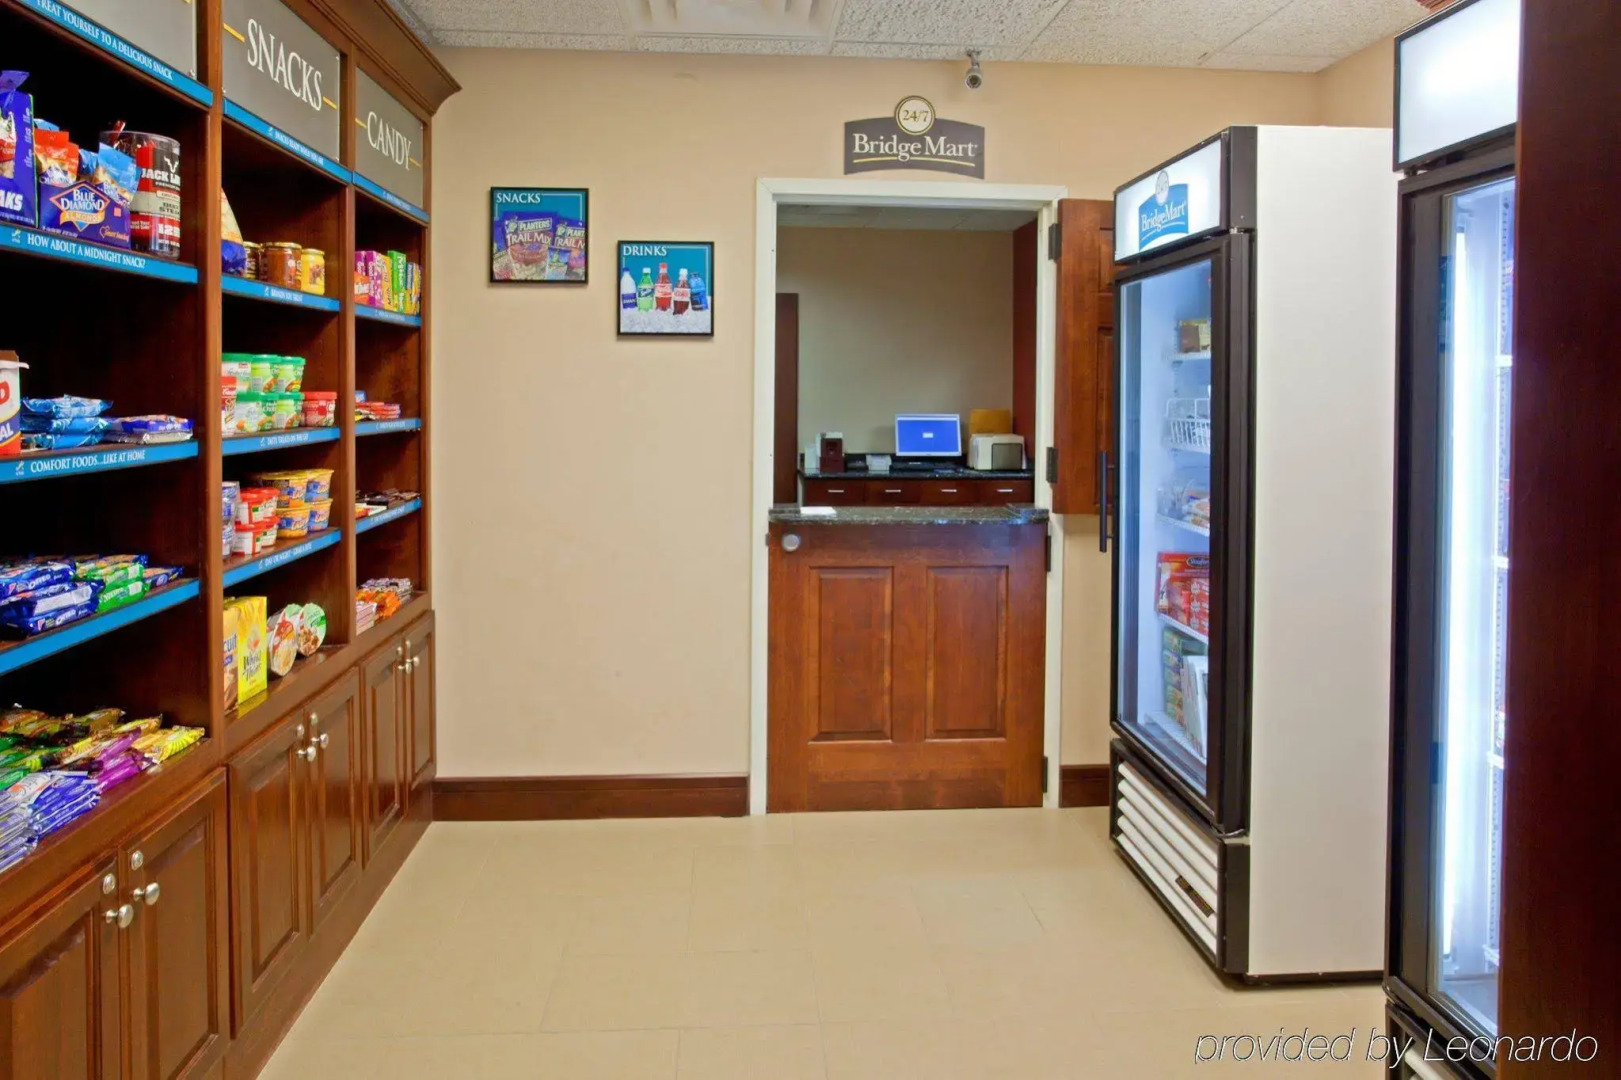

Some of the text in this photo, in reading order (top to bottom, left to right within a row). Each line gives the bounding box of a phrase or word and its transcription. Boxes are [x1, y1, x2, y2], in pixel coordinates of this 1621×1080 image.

[37, 0, 173, 80] TREAT YOURSELF TO A DELICIOUS SNACK
[247, 18, 323, 111] SNACKS
[902, 109, 929, 123] 24/7
[367, 111, 412, 171] CANDY
[141, 168, 168, 182] JACK
[73, 189, 96, 202] BLUE
[496, 193, 541, 204] SNACKS
[60, 197, 104, 211] DIAMOND
[519, 220, 550, 230] PLANTERS
[506, 232, 532, 246] TRAIL
[27, 233, 146, 269] HOW ABOUT A MIDNIGHT SNACK?
[622, 245, 667, 256] DRINKS
[30, 458, 71, 473] COMFORT
[118, 452, 126, 463] AT
[127, 450, 146, 461] HOME
